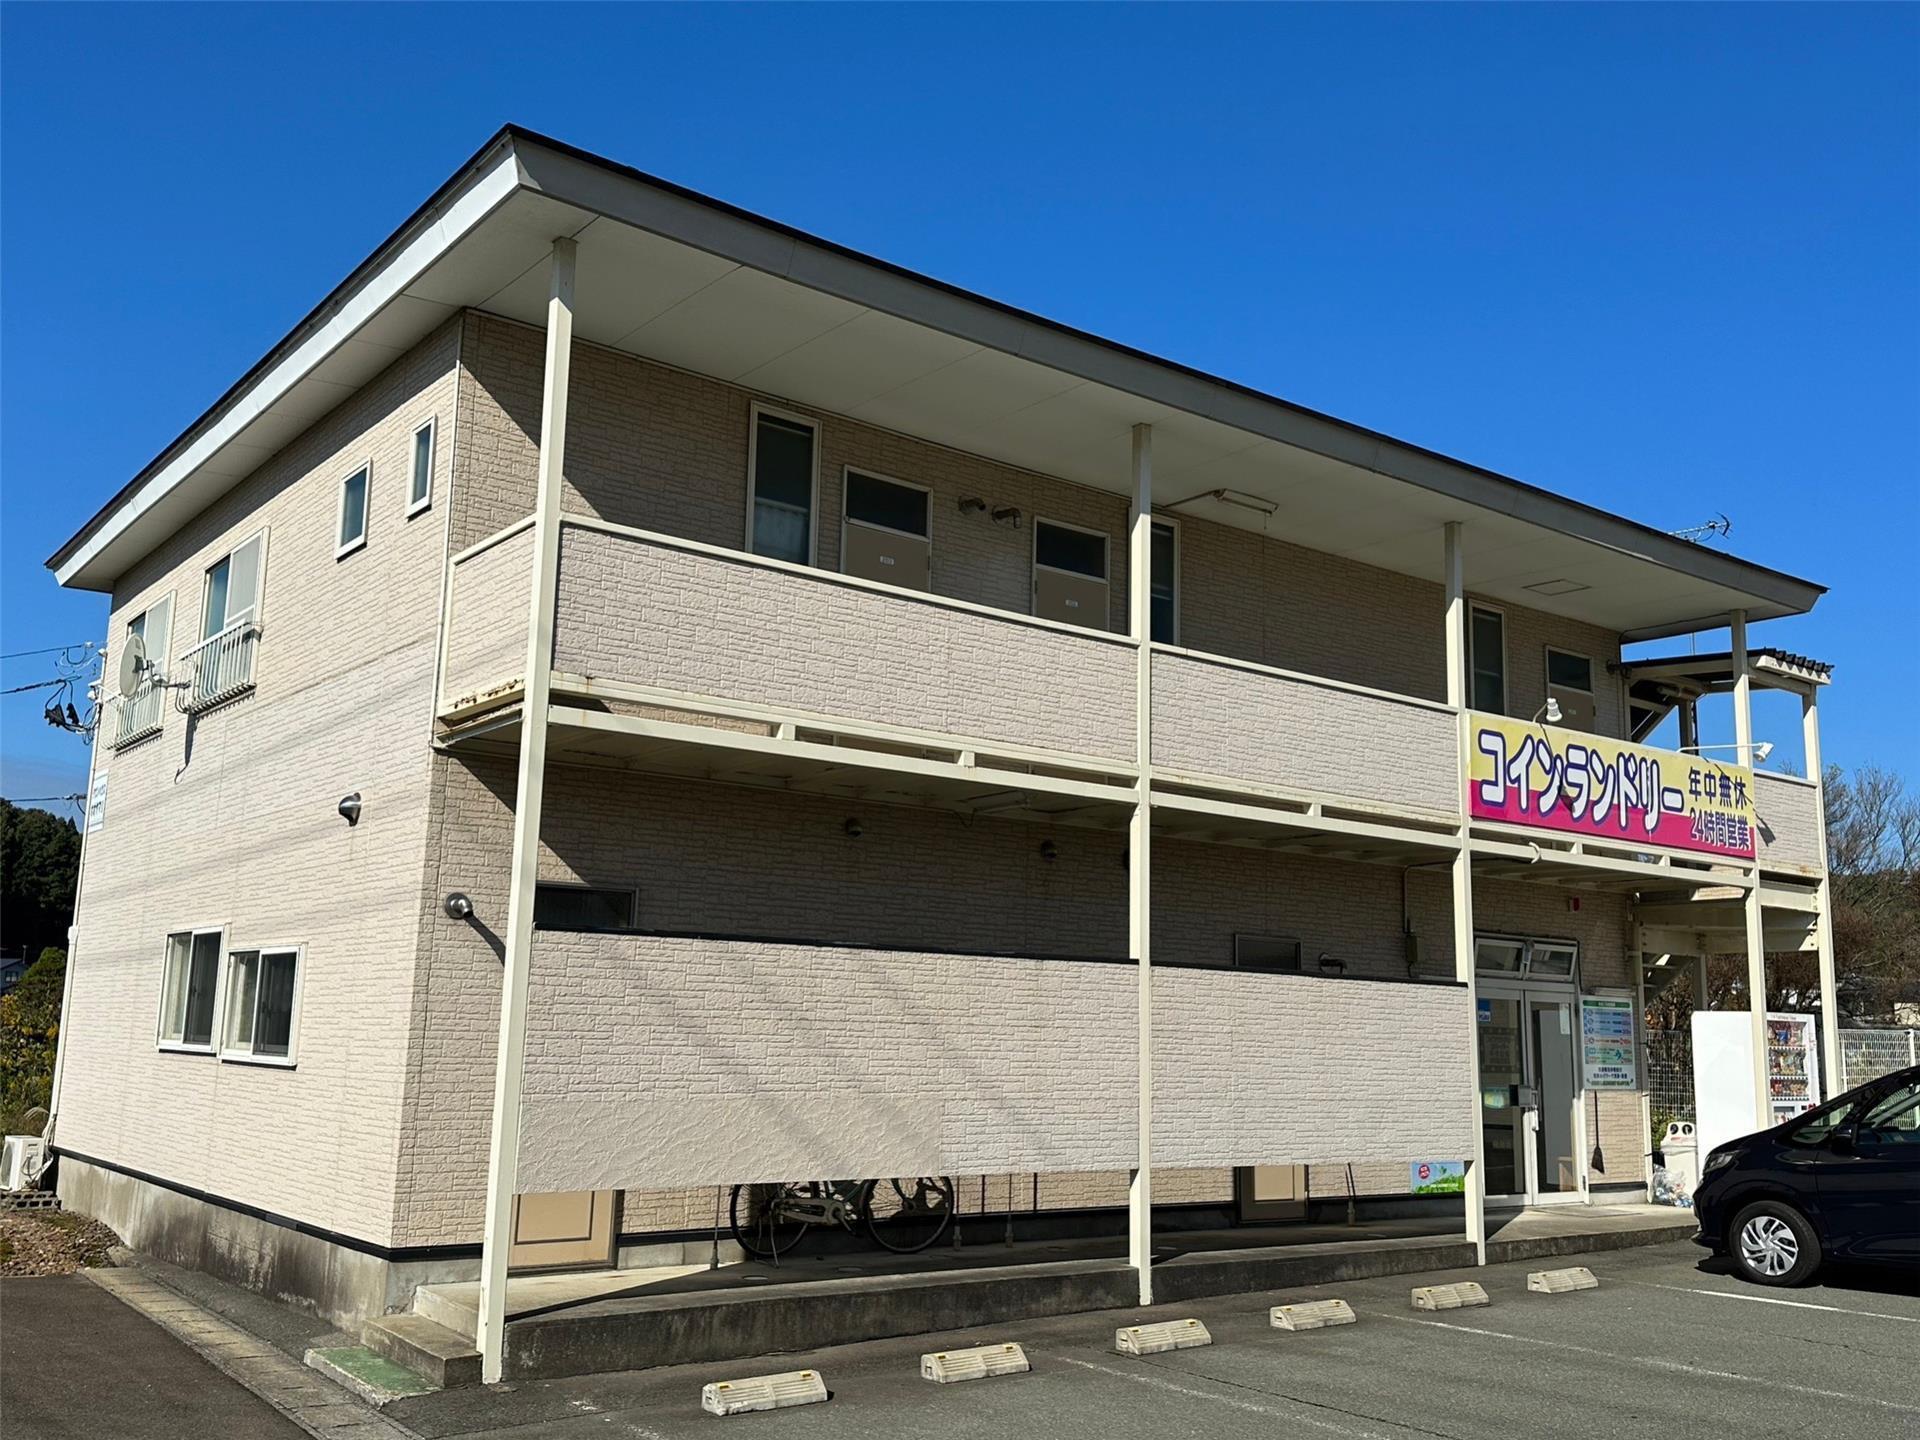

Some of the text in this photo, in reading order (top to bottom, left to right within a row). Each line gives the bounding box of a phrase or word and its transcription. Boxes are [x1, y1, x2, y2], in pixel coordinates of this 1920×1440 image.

[1478, 728, 1684, 832] コインランドリー
[1688, 765, 1748, 810] 年中無休
[1689, 807, 1751, 851] 24時間営業
